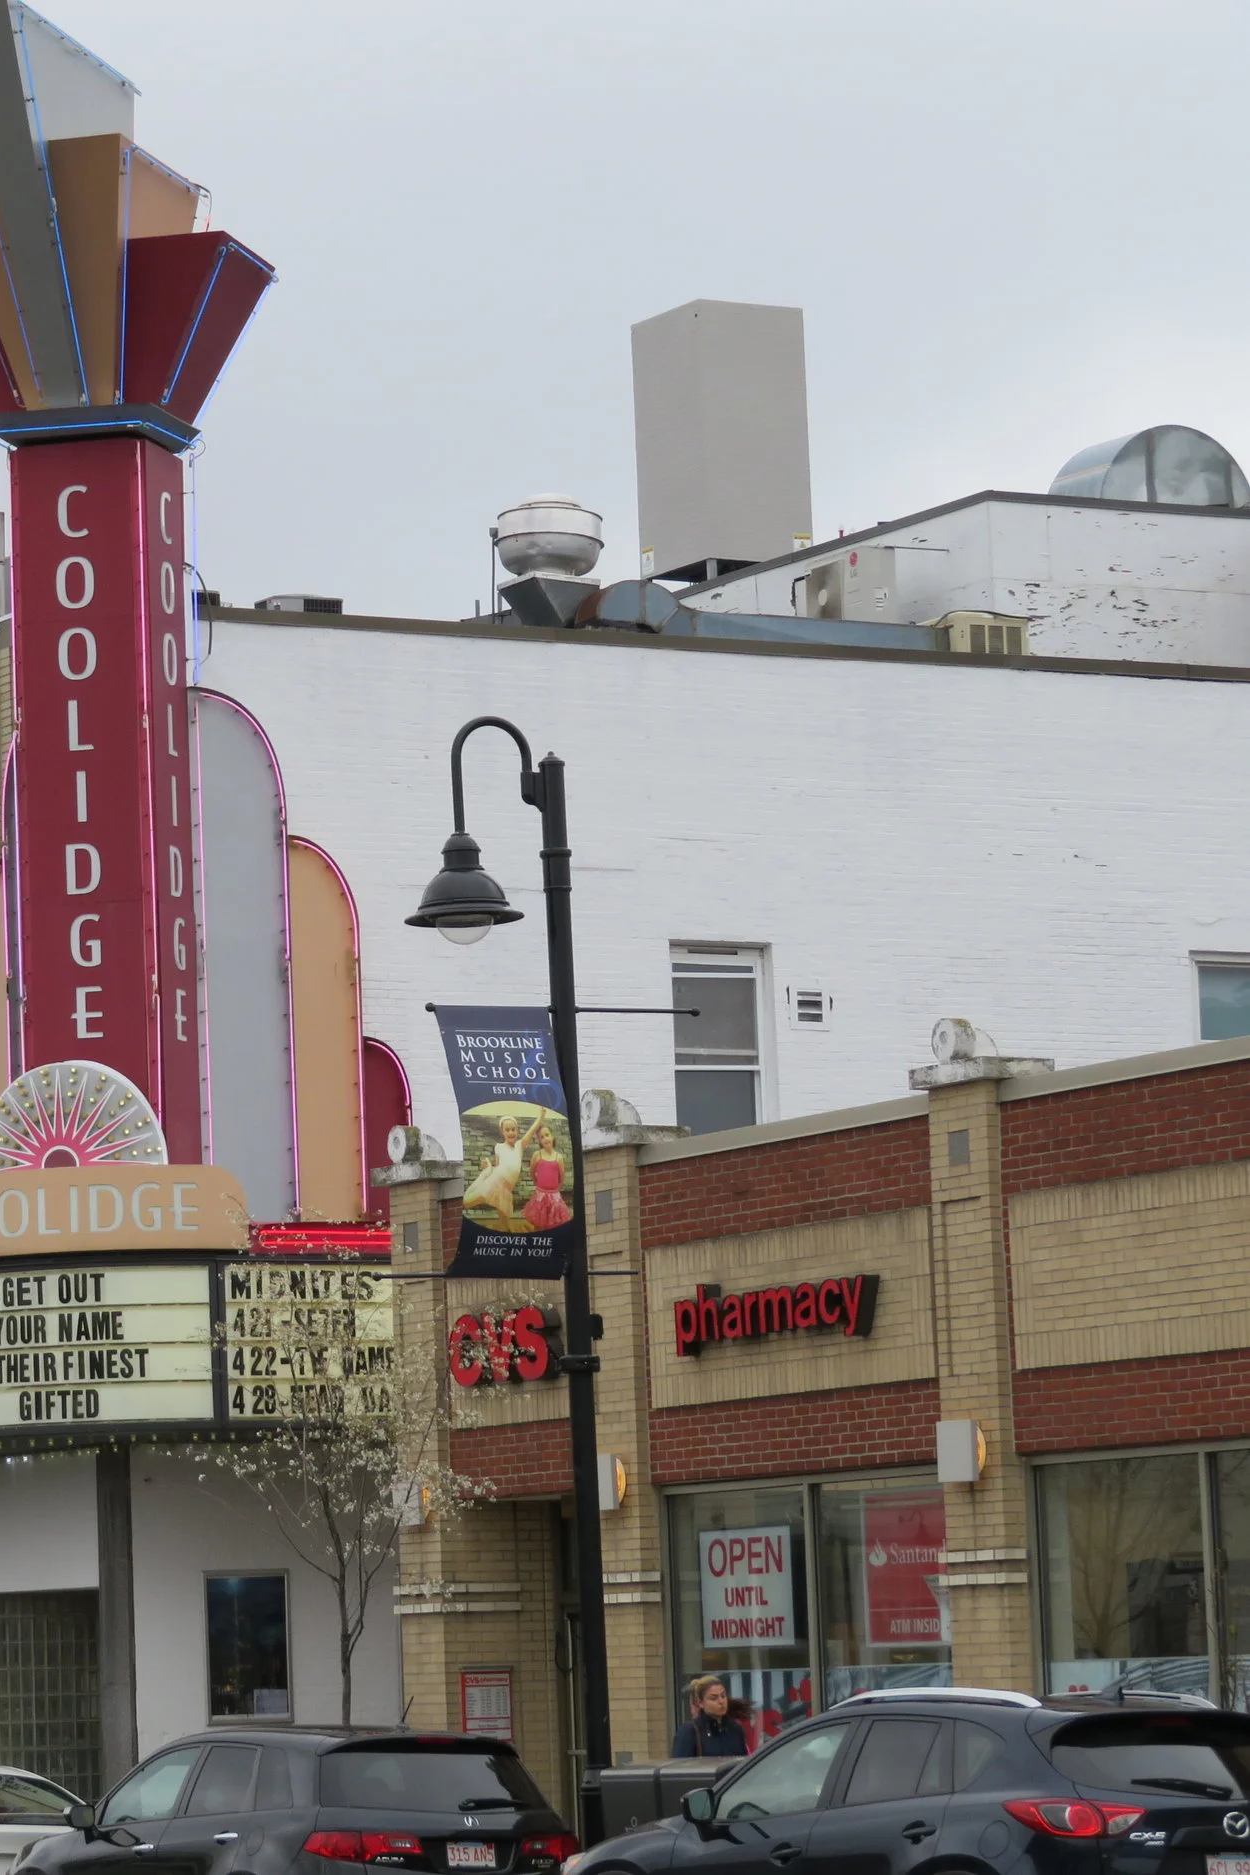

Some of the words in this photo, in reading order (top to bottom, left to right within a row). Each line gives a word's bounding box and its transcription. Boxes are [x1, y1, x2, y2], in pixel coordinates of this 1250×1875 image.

[55, 485, 104, 1039] COOLIDGE
[158, 491, 188, 1042] COOLIDGE
[455, 1034, 543, 1049] BROOKLINE
[460, 1049, 547, 1065] MUSIC
[463, 1064, 550, 1080] SCHOOL
[492, 1086, 506, 1095] EST
[509, 1086, 527, 1095] 1924
[473, 1247, 507, 1256] MUSIC
[510, 1248, 523, 1257] IN
[528, 1248, 553, 1257] YOU!
[476, 1235, 527, 1246] DISCOVER
[532, 1236, 553, 1246] THE
[3, 1276, 46, 1307] GET
[58, 1273, 105, 1304] OUT
[231, 1270, 374, 1300] MIDNITES
[59, 1311, 124, 1342] NAME
[674, 1274, 863, 1357] pharmacy
[449, 1305, 549, 1388] CVS
[63, 1348, 149, 1380] FINEST
[19, 1388, 99, 1421] GIFTED
[708, 1535, 783, 1577] OPEN
[725, 1586, 768, 1607] UNTIL
[711, 1616, 785, 1639] MIDNIGHT
[890, 1618, 911, 1634] ATM
[1129, 1831, 1166, 1840] CX-5
[448, 1847, 470, 1863] 315
[473, 1846, 495, 1863] AN5
